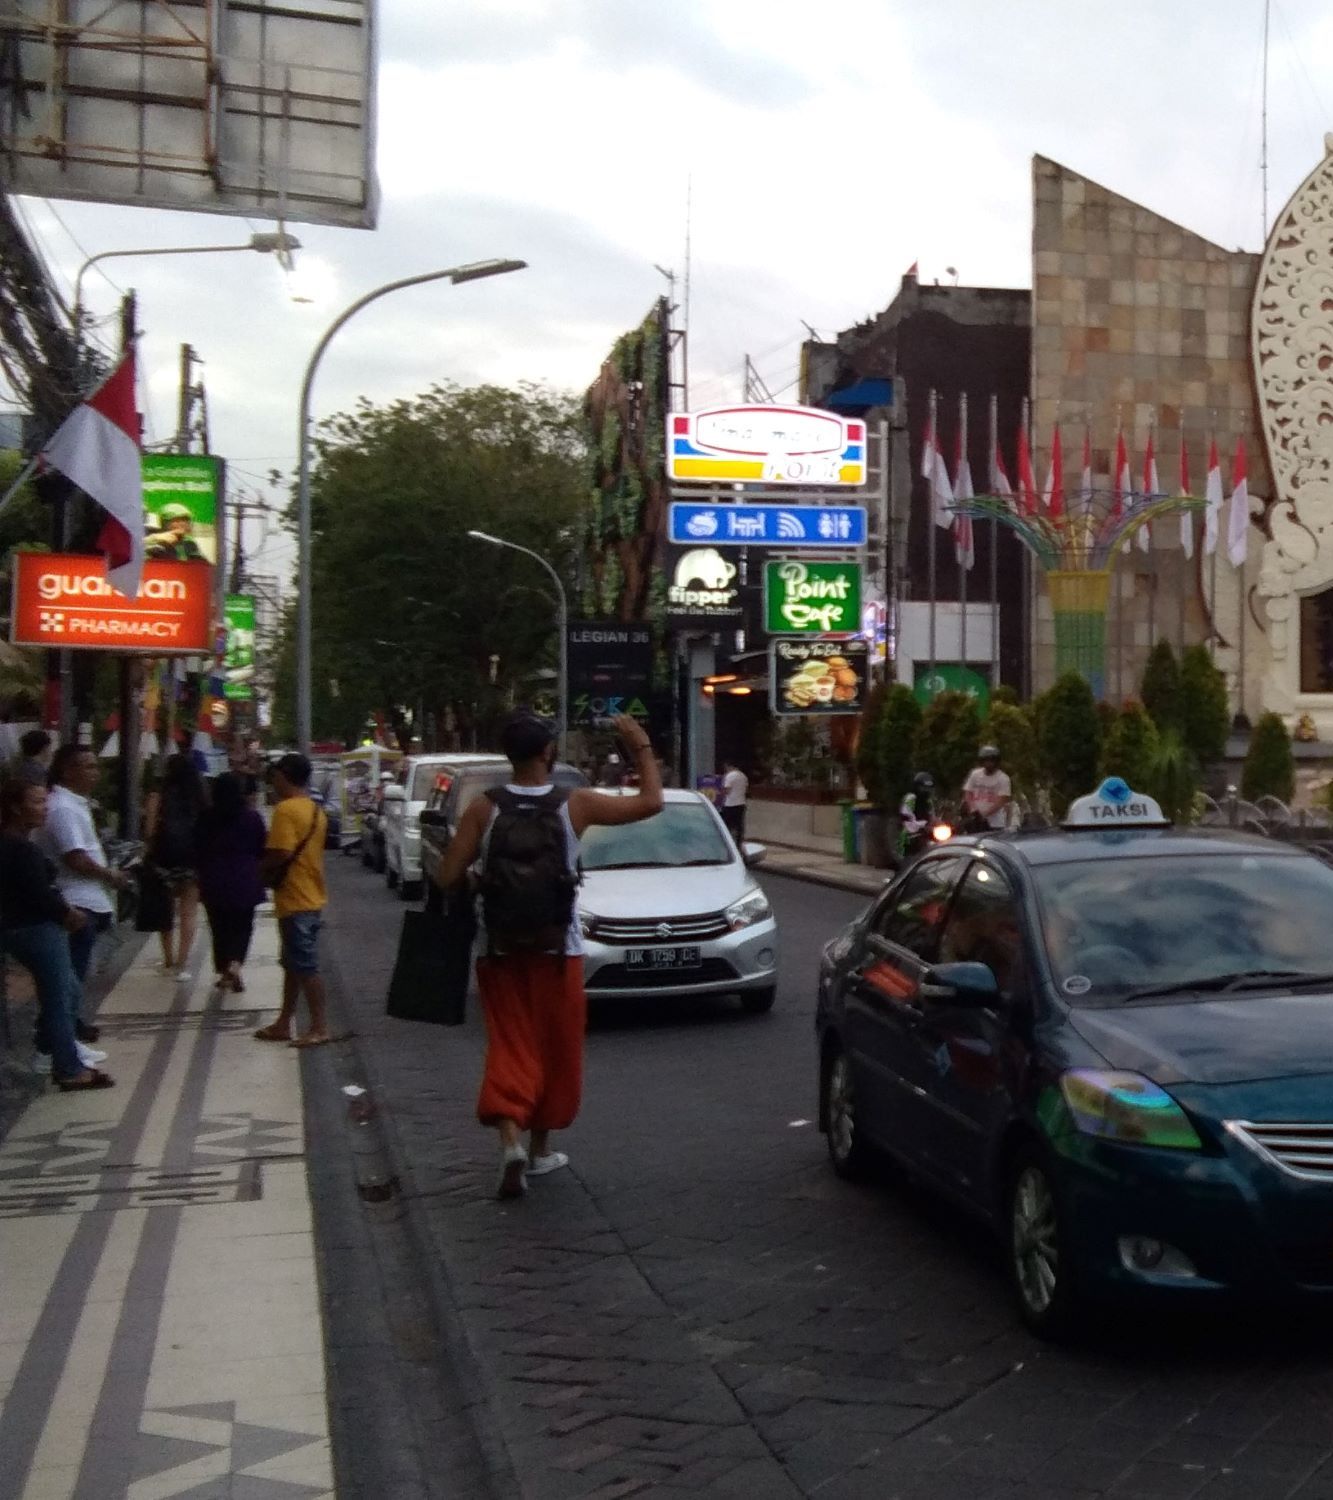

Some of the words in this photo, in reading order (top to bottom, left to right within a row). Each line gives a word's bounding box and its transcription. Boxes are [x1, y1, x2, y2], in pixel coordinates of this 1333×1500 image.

[778, 563, 851, 599] Point
[68, 618, 182, 637] PHARMACY
[572, 631, 628, 643] LEGIAN
[1089, 803, 1148, 819] TAKSI
